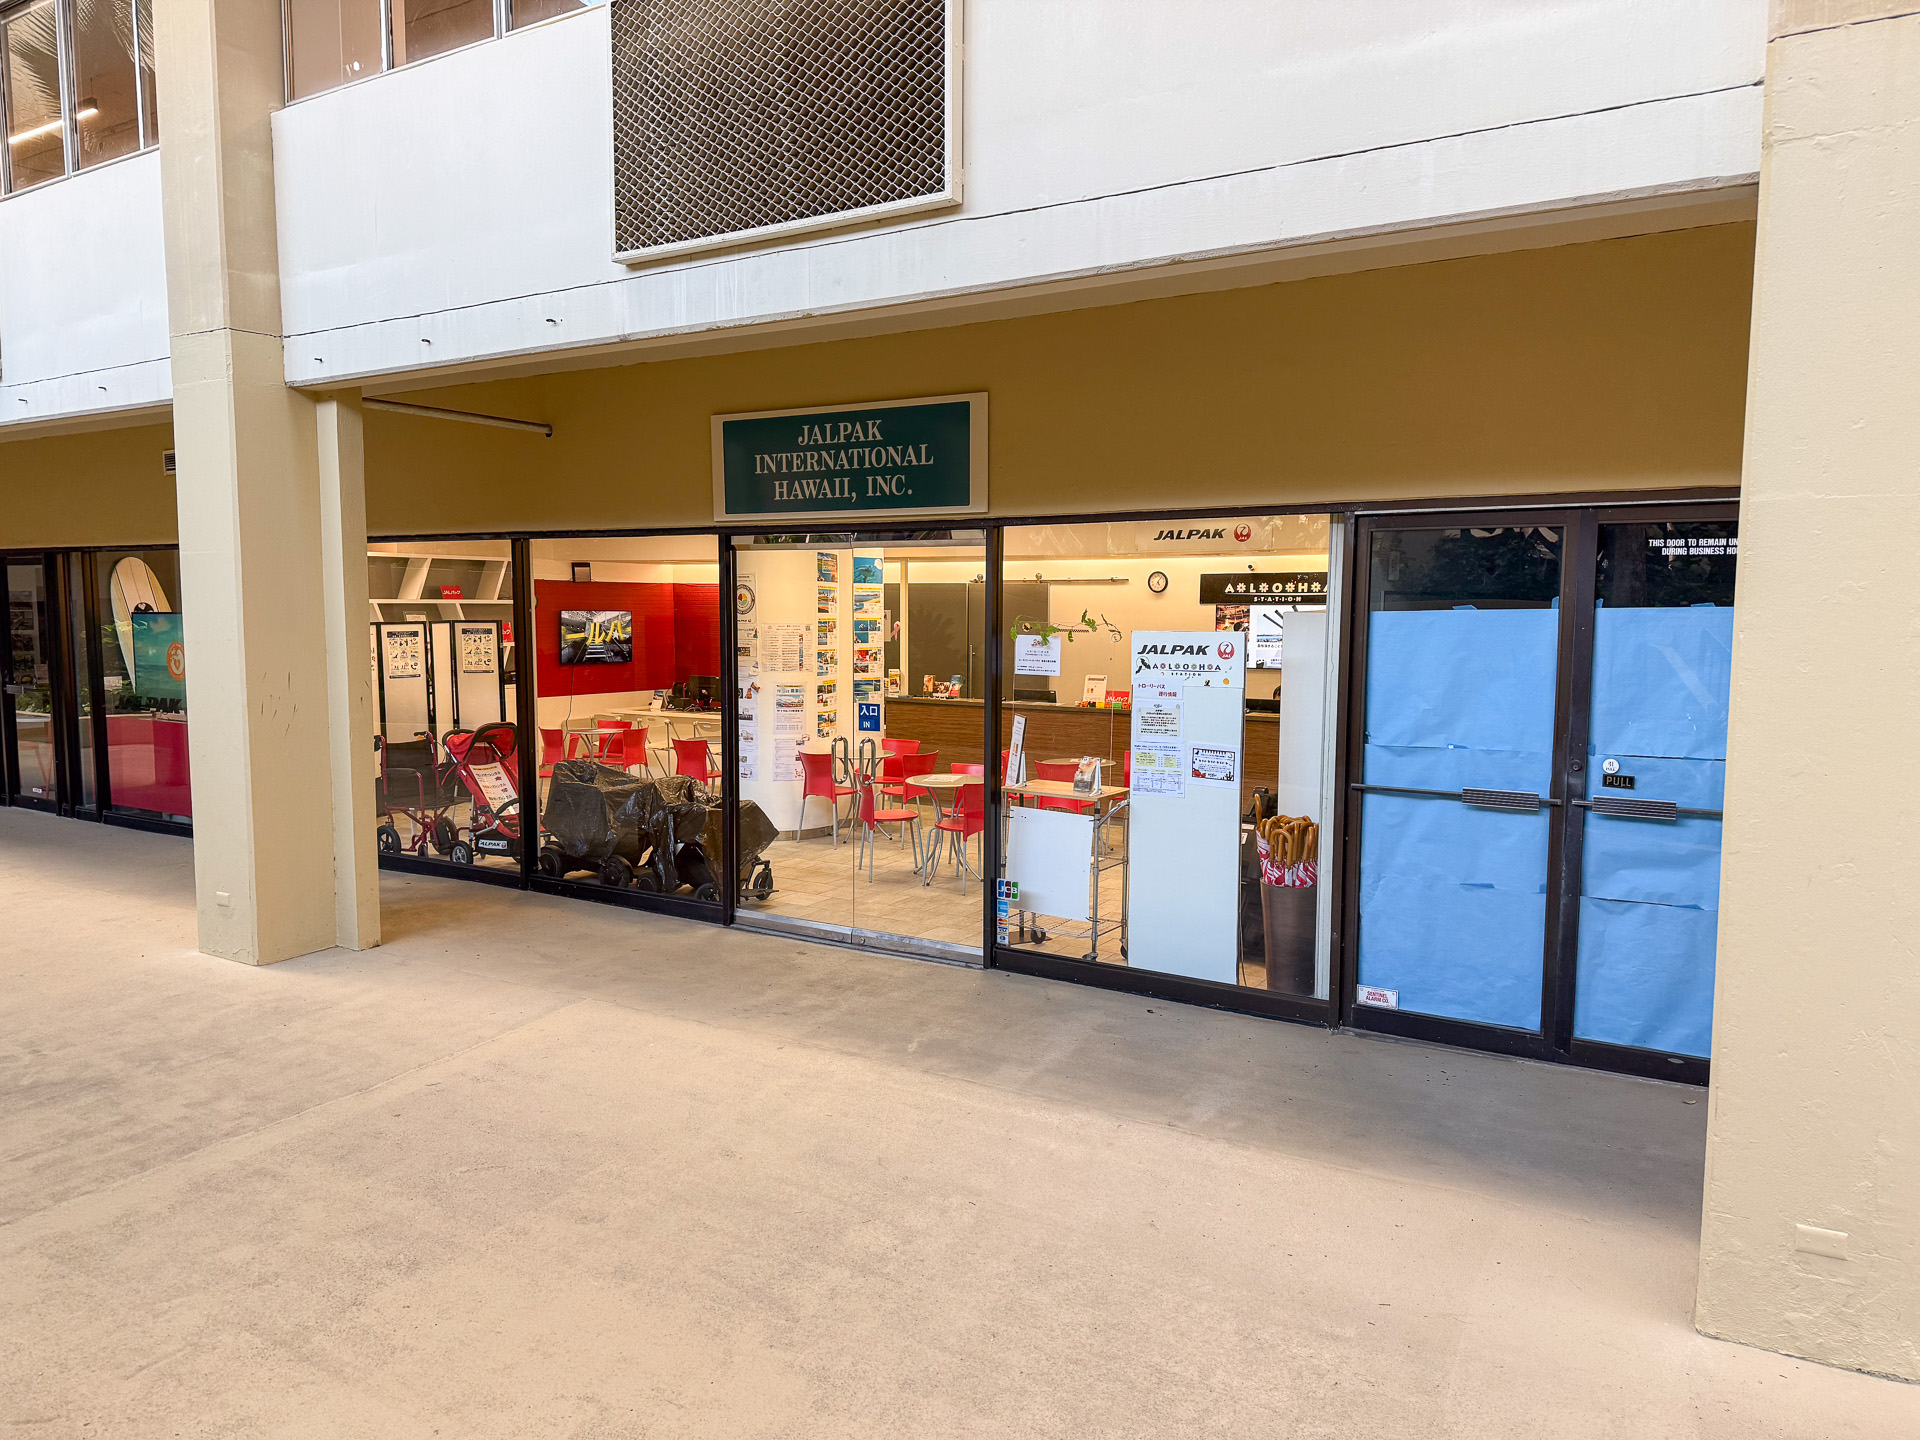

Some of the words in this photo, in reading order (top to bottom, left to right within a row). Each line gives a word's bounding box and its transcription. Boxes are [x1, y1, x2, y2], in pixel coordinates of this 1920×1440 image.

[797, 419, 883, 446] JALPAK
[754, 443, 934, 474] INTERNATIONAL
[773, 477, 857, 502] HAWAII,
[866, 474, 913, 497] INC.
[1153, 528, 1227, 541] JALPAK
[1648, 539, 1665, 547] THIS
[1666, 539, 1685, 547] DOOR
[1687, 539, 1697, 547] TO
[1698, 538, 1727, 547] REMAIN
[1661, 547, 1688, 556] DURING
[1689, 546, 1725, 556] BUSINESS
[1726, 546, 1738, 555] HO
[1137, 644, 1211, 656] JALPAK
[860, 705, 878, 716] 入口
[863, 720, 871, 728] IN
[1606, 776, 1632, 787] PULL
